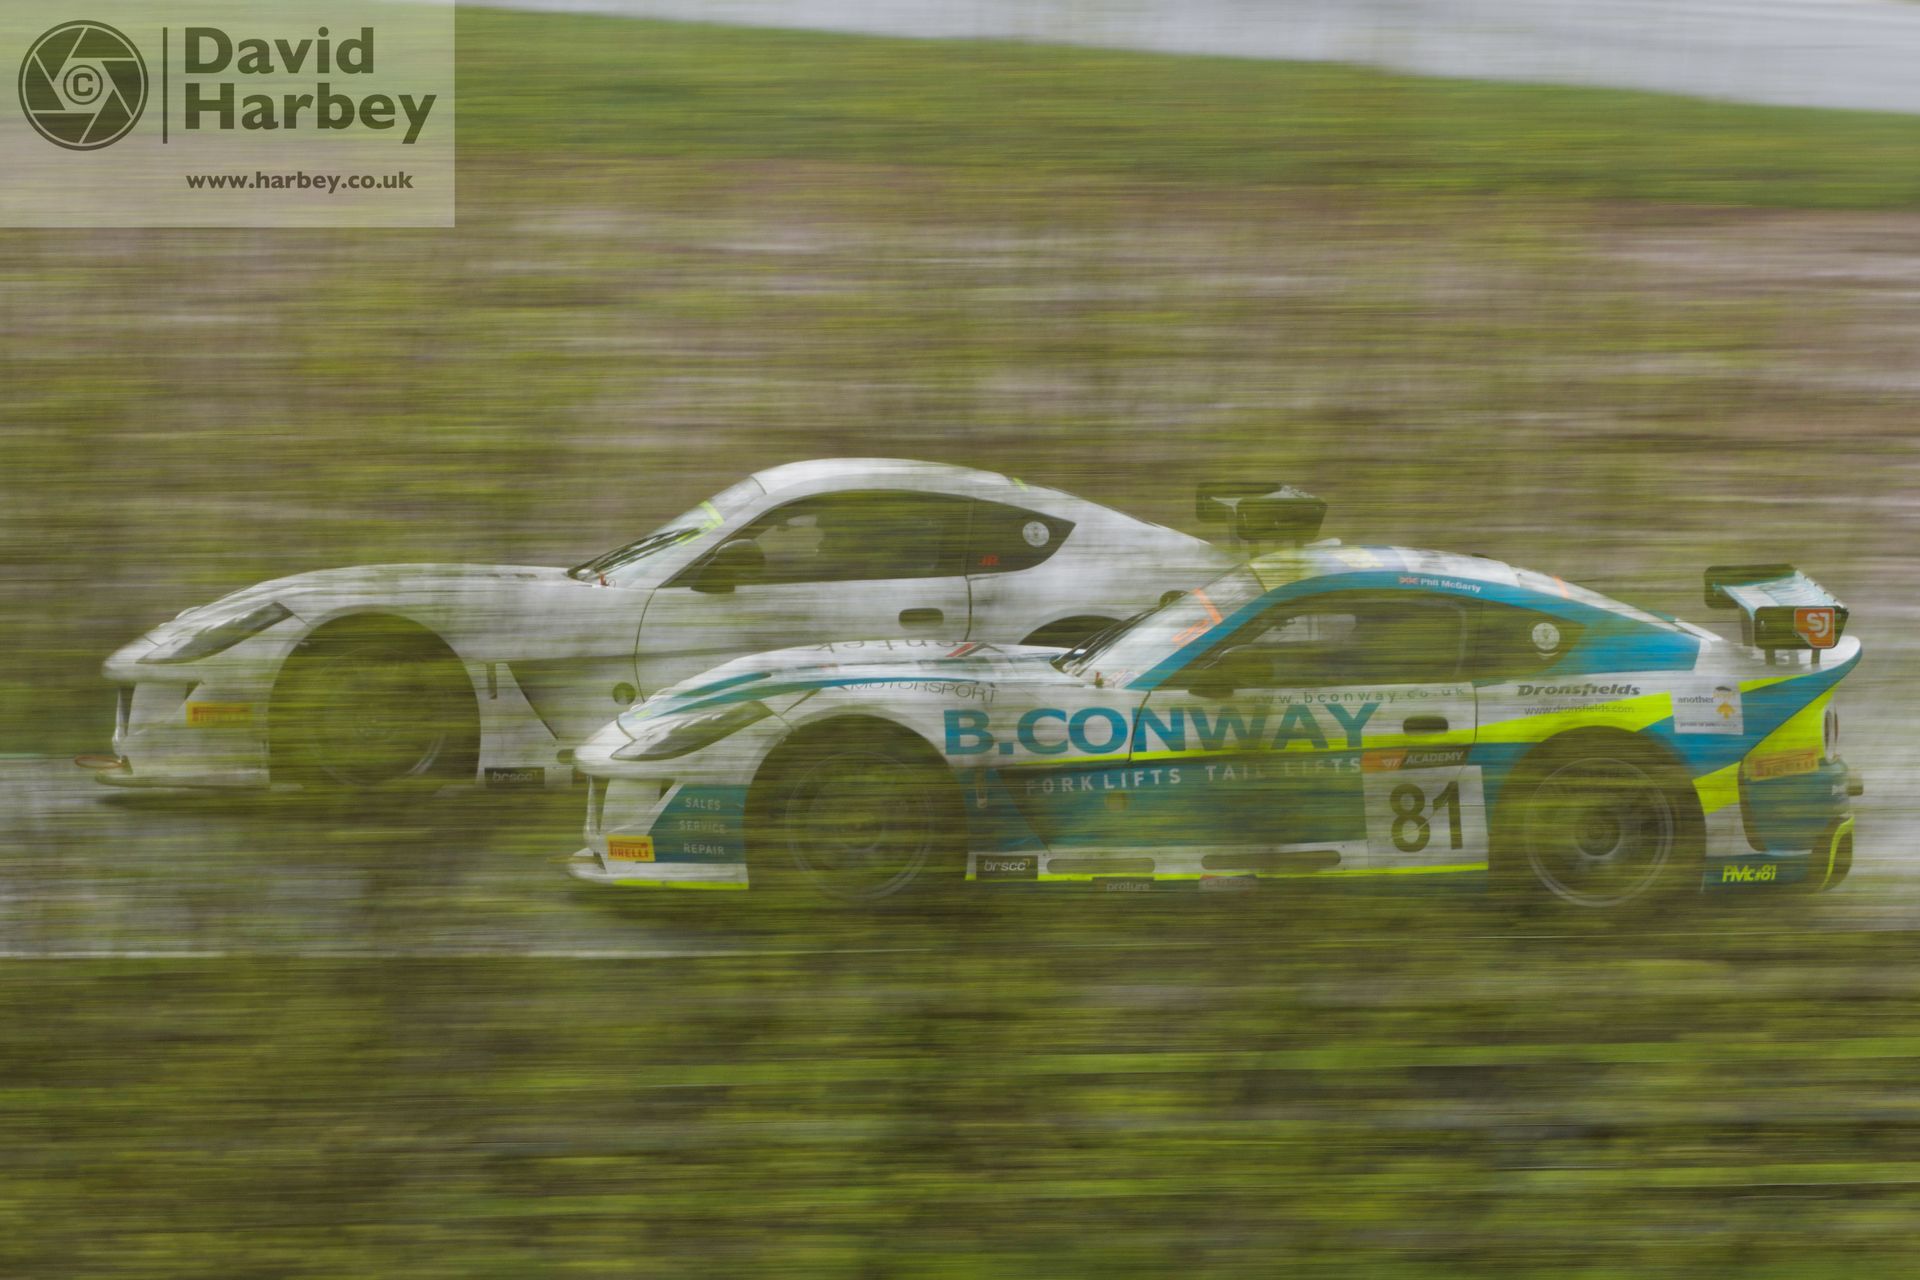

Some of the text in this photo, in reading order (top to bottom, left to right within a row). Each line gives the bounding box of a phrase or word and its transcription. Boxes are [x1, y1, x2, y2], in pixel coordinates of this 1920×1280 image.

[1420, 578, 1439, 586] Phil
[1806, 612, 1830, 638] SJ
[1518, 683, 1641, 697] Dronsfields
[1524, 703, 1634, 715] www.dronsfields.com
[944, 702, 1381, 755] B.CONWAY
[1405, 751, 1464, 765] ACADEMY
[1205, 765, 1264, 781] TAIL
[1284, 758, 1361, 778] LIFTS
[685, 798, 721, 811] SALES
[1390, 781, 1463, 853] 81
[679, 820, 727, 834] SERVICE
[608, 841, 649, 858] PIRELLI
[683, 843, 725, 855] REPAIR
[984, 859, 1026, 871] brscc
